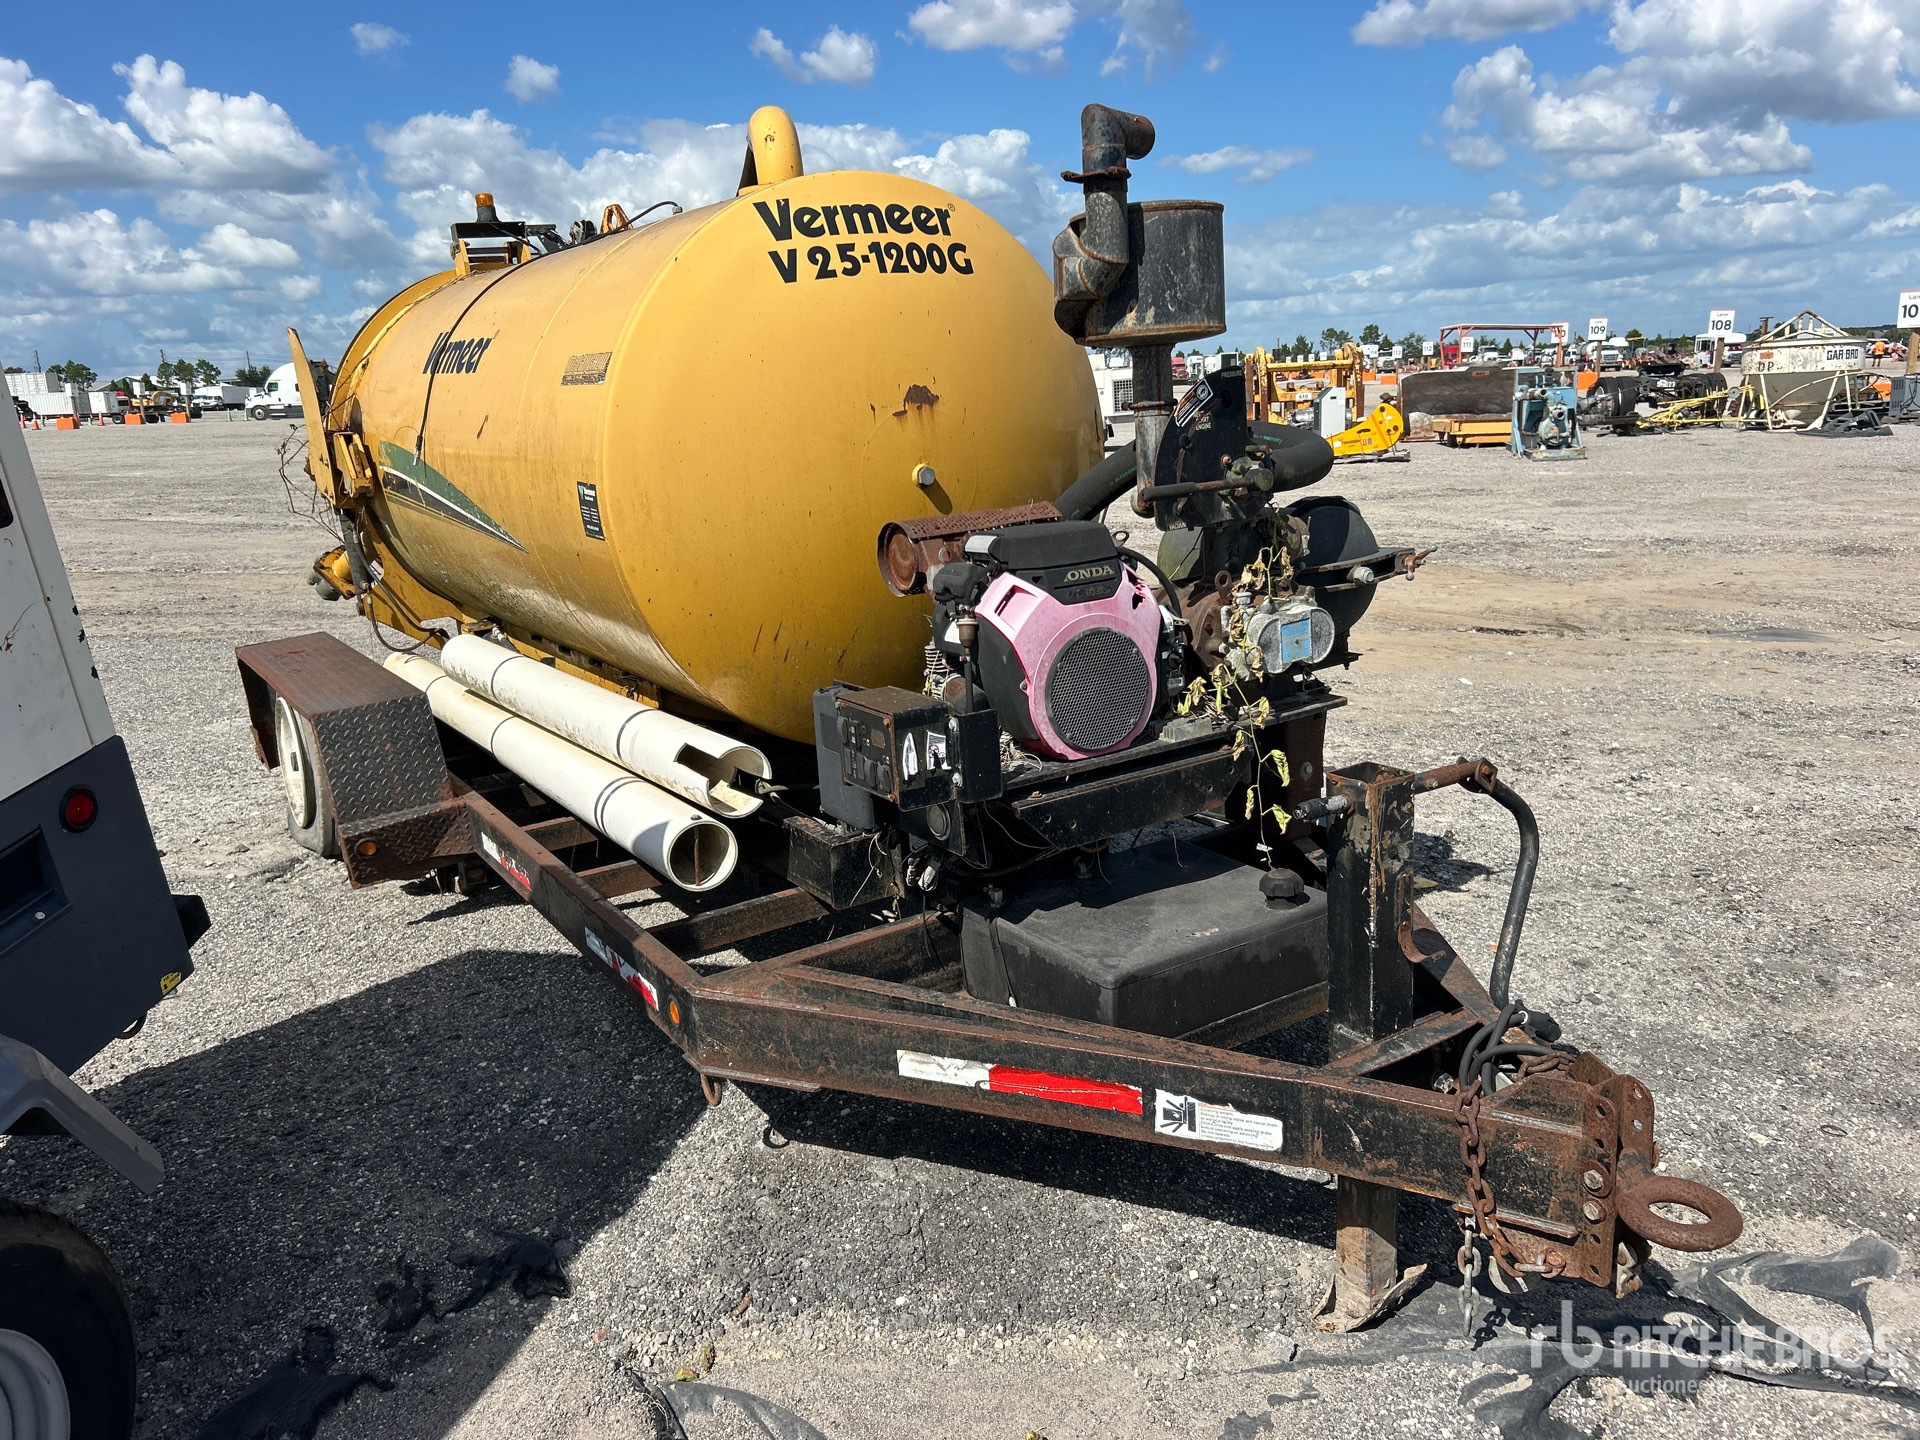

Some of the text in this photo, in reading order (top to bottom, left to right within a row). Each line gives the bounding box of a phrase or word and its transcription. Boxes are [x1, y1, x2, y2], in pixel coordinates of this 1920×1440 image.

[768, 241, 975, 284] V 25-1200G
[1901, 304, 1919, 319] 10
[1590, 325, 1606, 335] 109
[1711, 319, 1732, 331] 108
[1221, 370, 1243, 378] PRESSURE
[1064, 565, 1115, 582] ONDA
